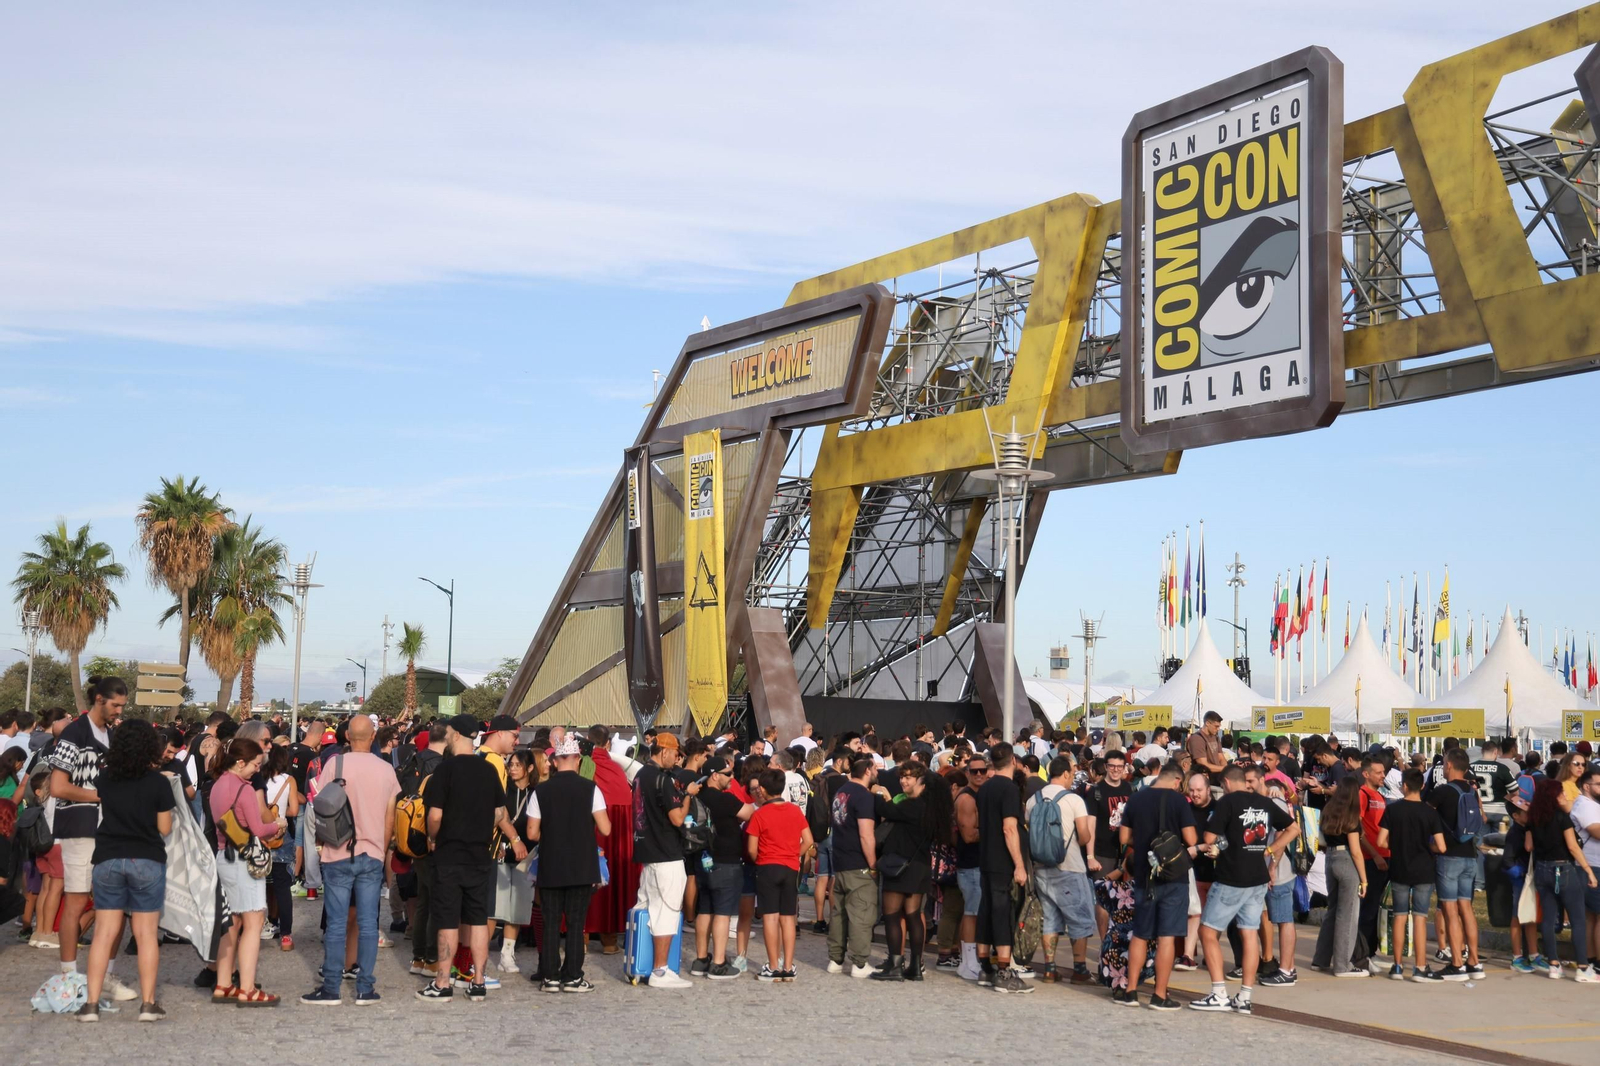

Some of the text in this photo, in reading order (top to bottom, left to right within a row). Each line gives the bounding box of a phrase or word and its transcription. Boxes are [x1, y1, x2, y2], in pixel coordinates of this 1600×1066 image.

[1152, 97, 1301, 167] SAN DIEGO
[1203, 127, 1298, 221] CON
[1154, 163, 1200, 371] COMIC
[730, 337, 815, 399] WELCOME
[1153, 359, 1301, 411] MÁLAGA
[690, 463, 700, 510] COMIC
[699, 461, 713, 477] CON
[1469, 764, 1498, 773] TIGERS
